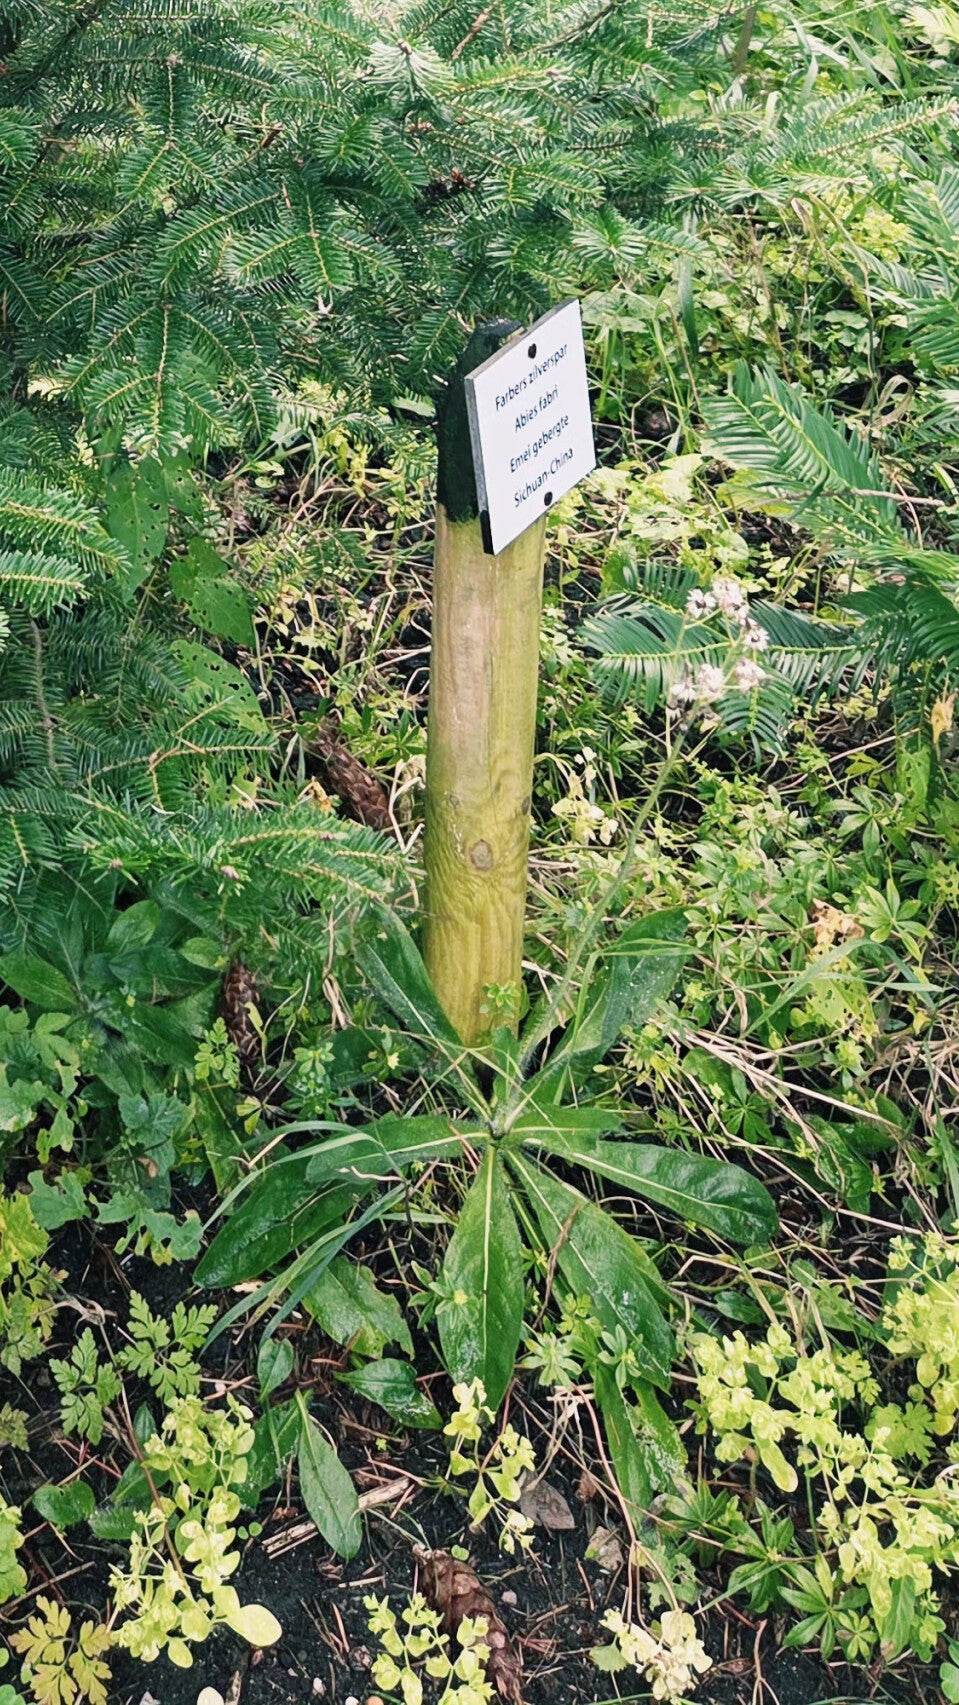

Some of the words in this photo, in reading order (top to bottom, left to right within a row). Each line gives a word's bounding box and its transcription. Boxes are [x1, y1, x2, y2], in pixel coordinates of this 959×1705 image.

[495, 377, 527, 412] Farbers
[528, 343, 568, 384] zilverspar
[514, 406, 538, 433] Abies
[538, 384, 559, 411] fabri
[510, 444, 531, 474] Emei
[531, 414, 569, 454] gebergte
[514, 447, 574, 508] Sichuan-China
